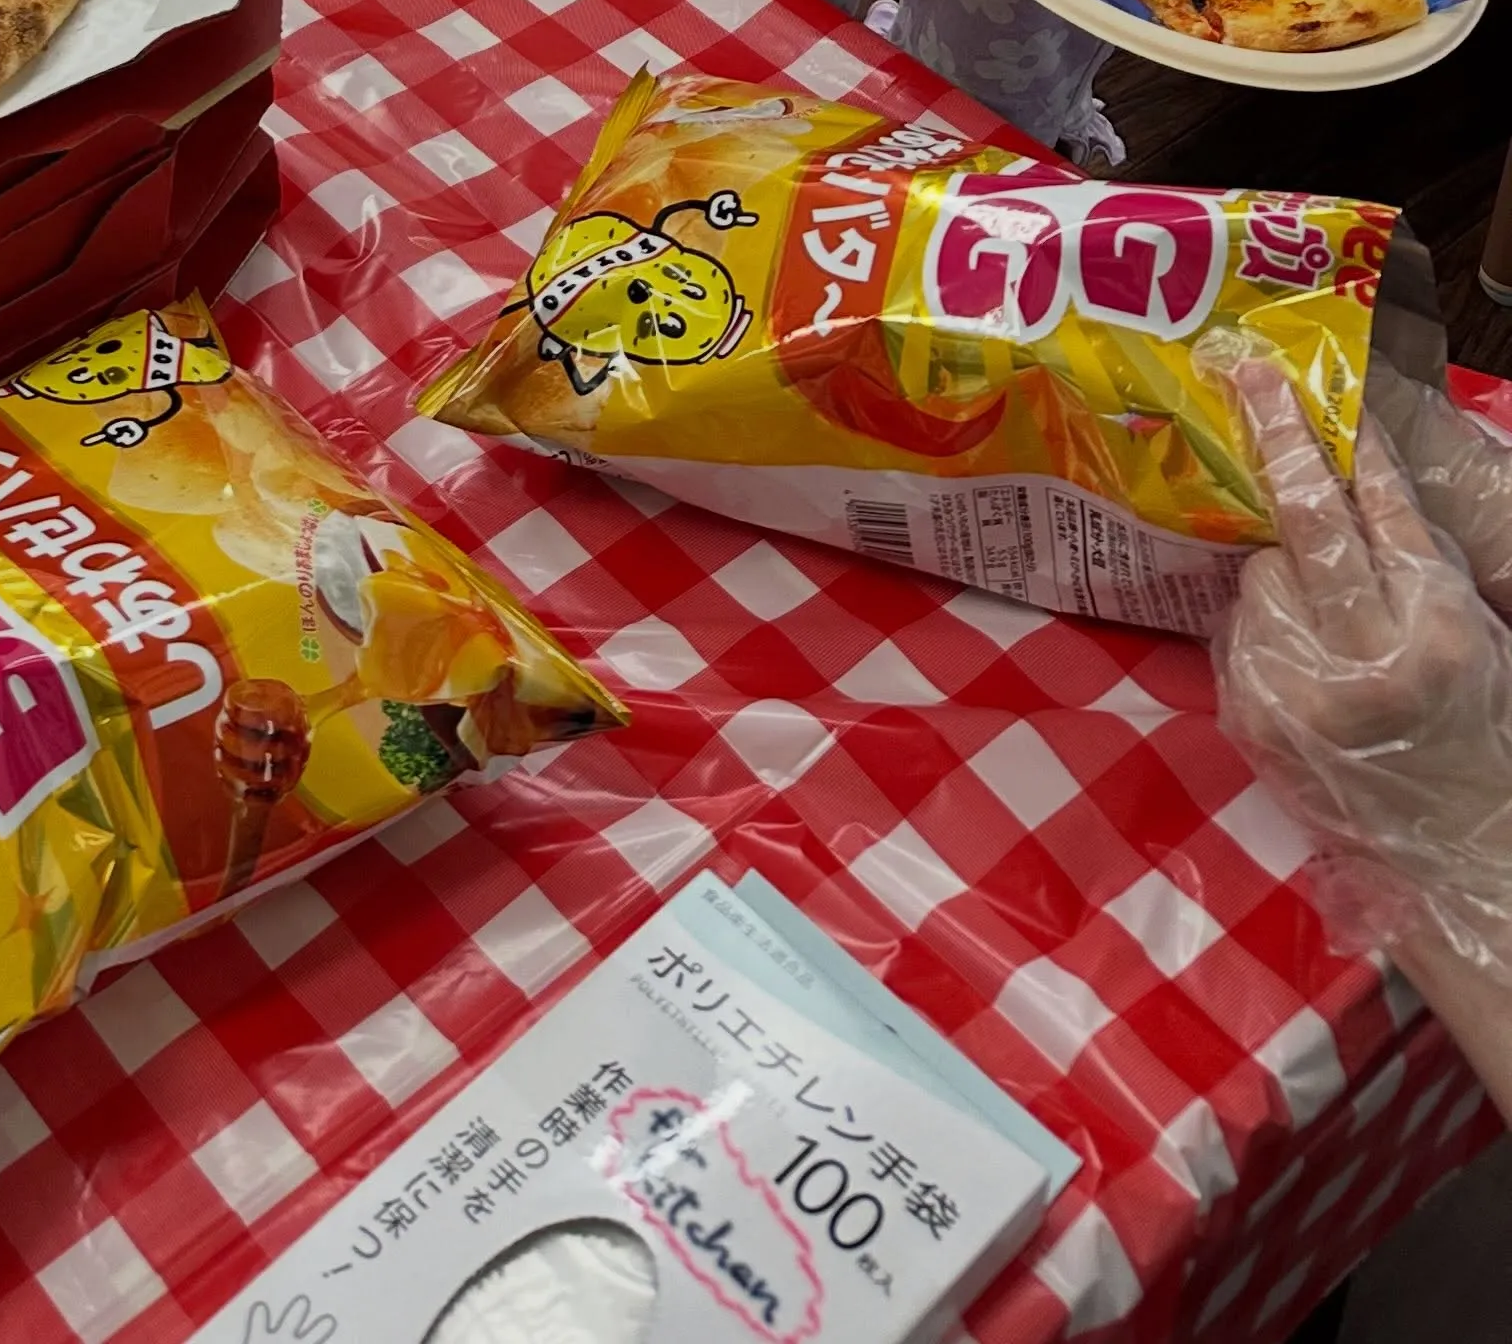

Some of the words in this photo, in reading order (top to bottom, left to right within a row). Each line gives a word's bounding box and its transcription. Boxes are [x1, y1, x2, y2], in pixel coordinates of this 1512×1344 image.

[463, 1059, 637, 1226] 作業時の手を
[647, 945, 961, 1241] ポリエチレン手袋
[773, 1135, 885, 1251] 100
